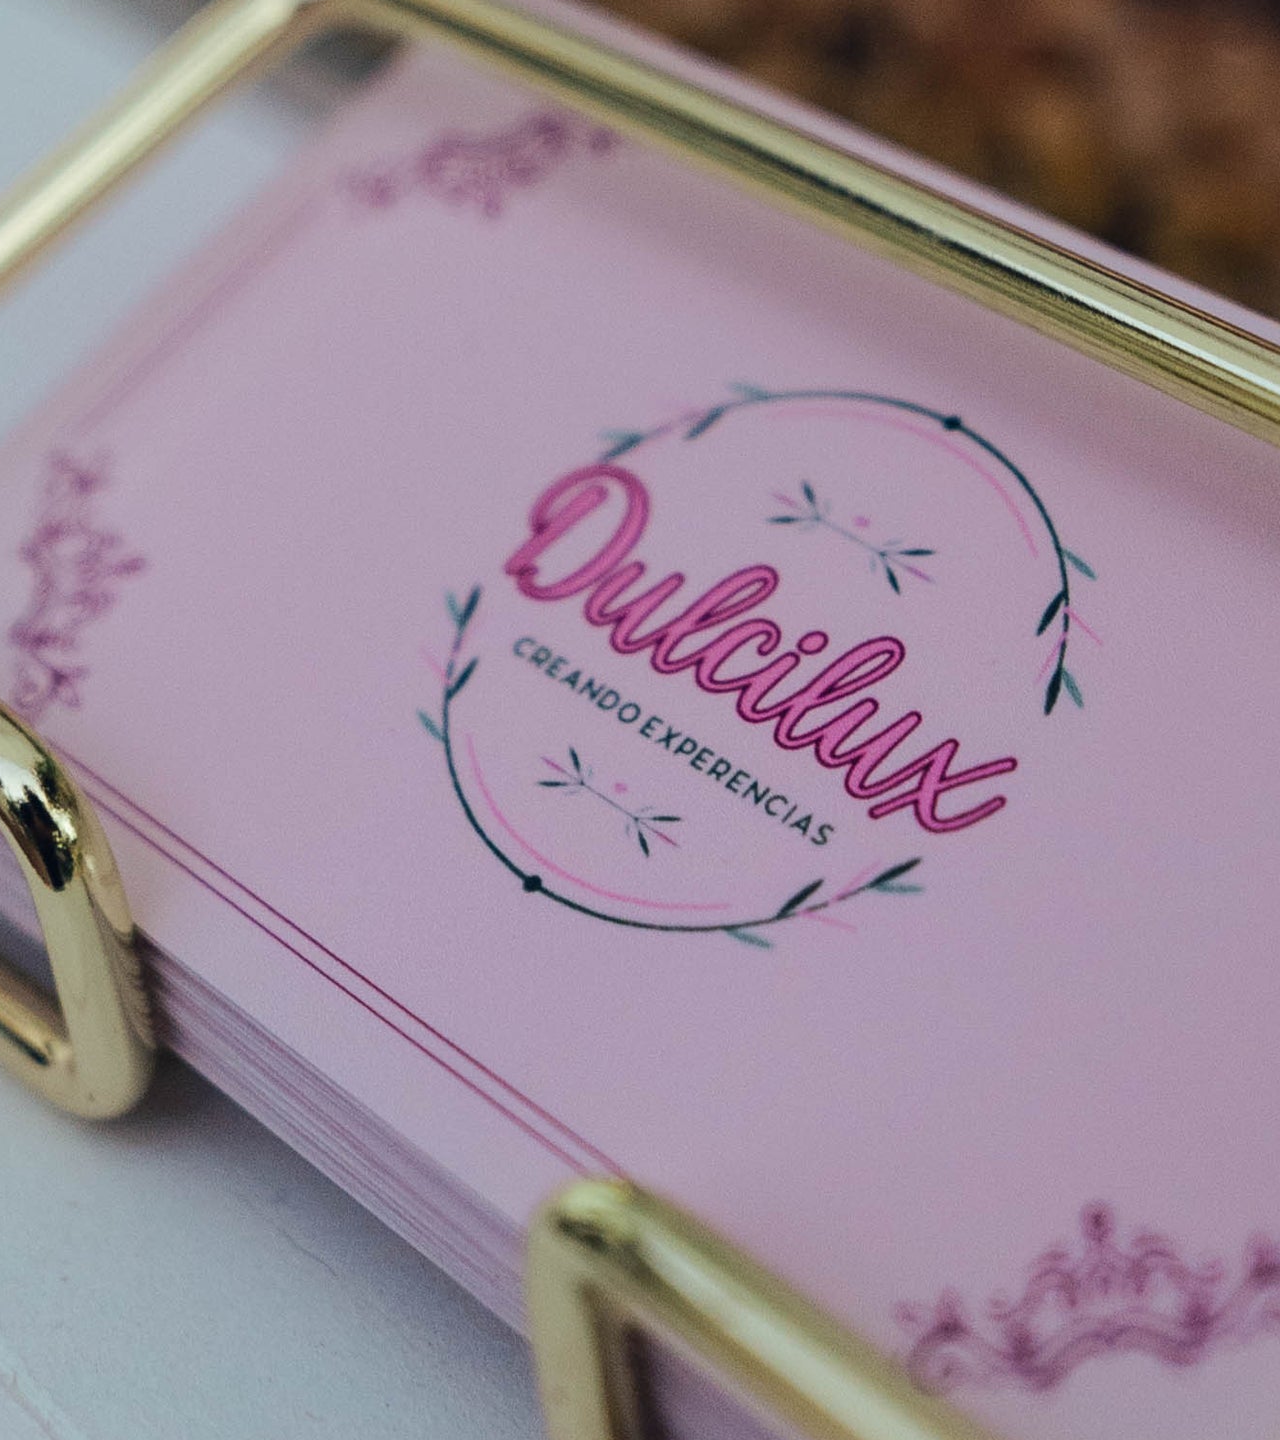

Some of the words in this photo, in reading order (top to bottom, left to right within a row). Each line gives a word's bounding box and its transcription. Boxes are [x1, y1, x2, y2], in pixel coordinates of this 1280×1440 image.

[505, 463, 1018, 833] Dulcilux
[513, 636, 640, 723] CREANDO
[639, 716, 835, 847] EXPERENCIAS
